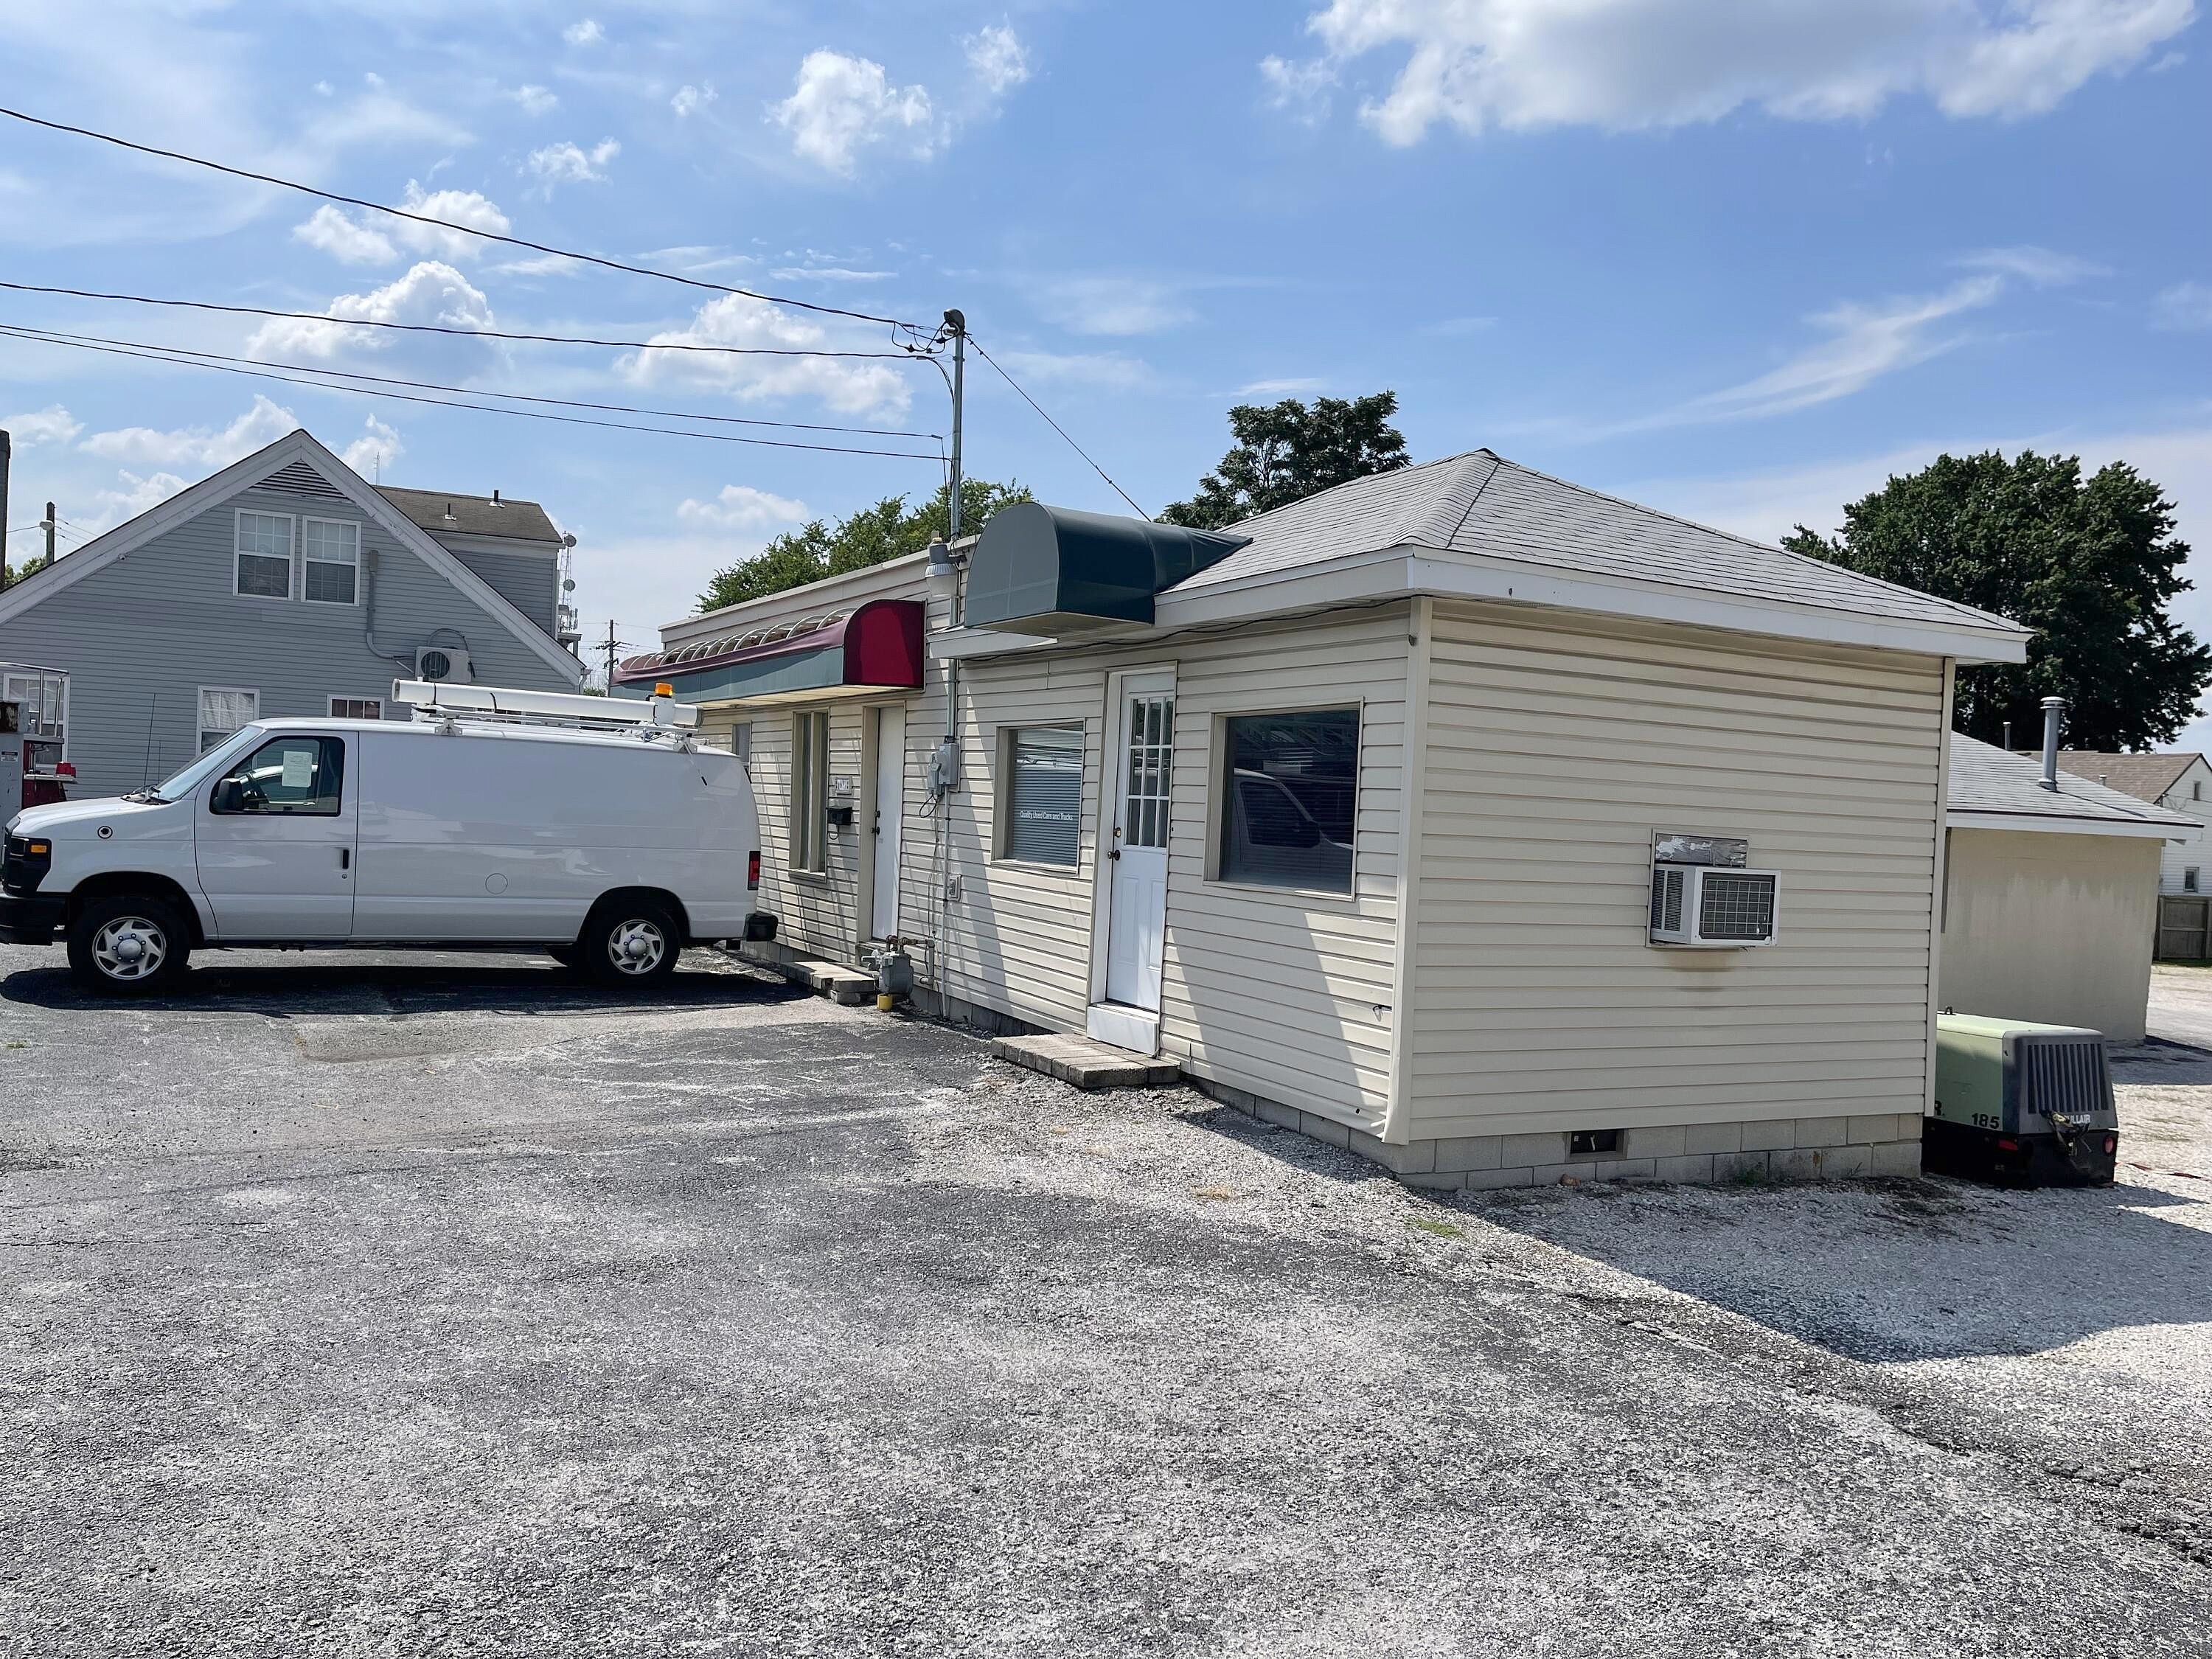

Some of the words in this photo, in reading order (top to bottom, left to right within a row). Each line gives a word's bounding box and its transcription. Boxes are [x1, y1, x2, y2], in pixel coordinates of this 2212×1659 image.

[1020, 810, 1032, 819] Quality
[1033, 811, 1043, 819] Used
[1060, 813, 1073, 821] Trucks
[1972, 1113, 2000, 1129] 185
